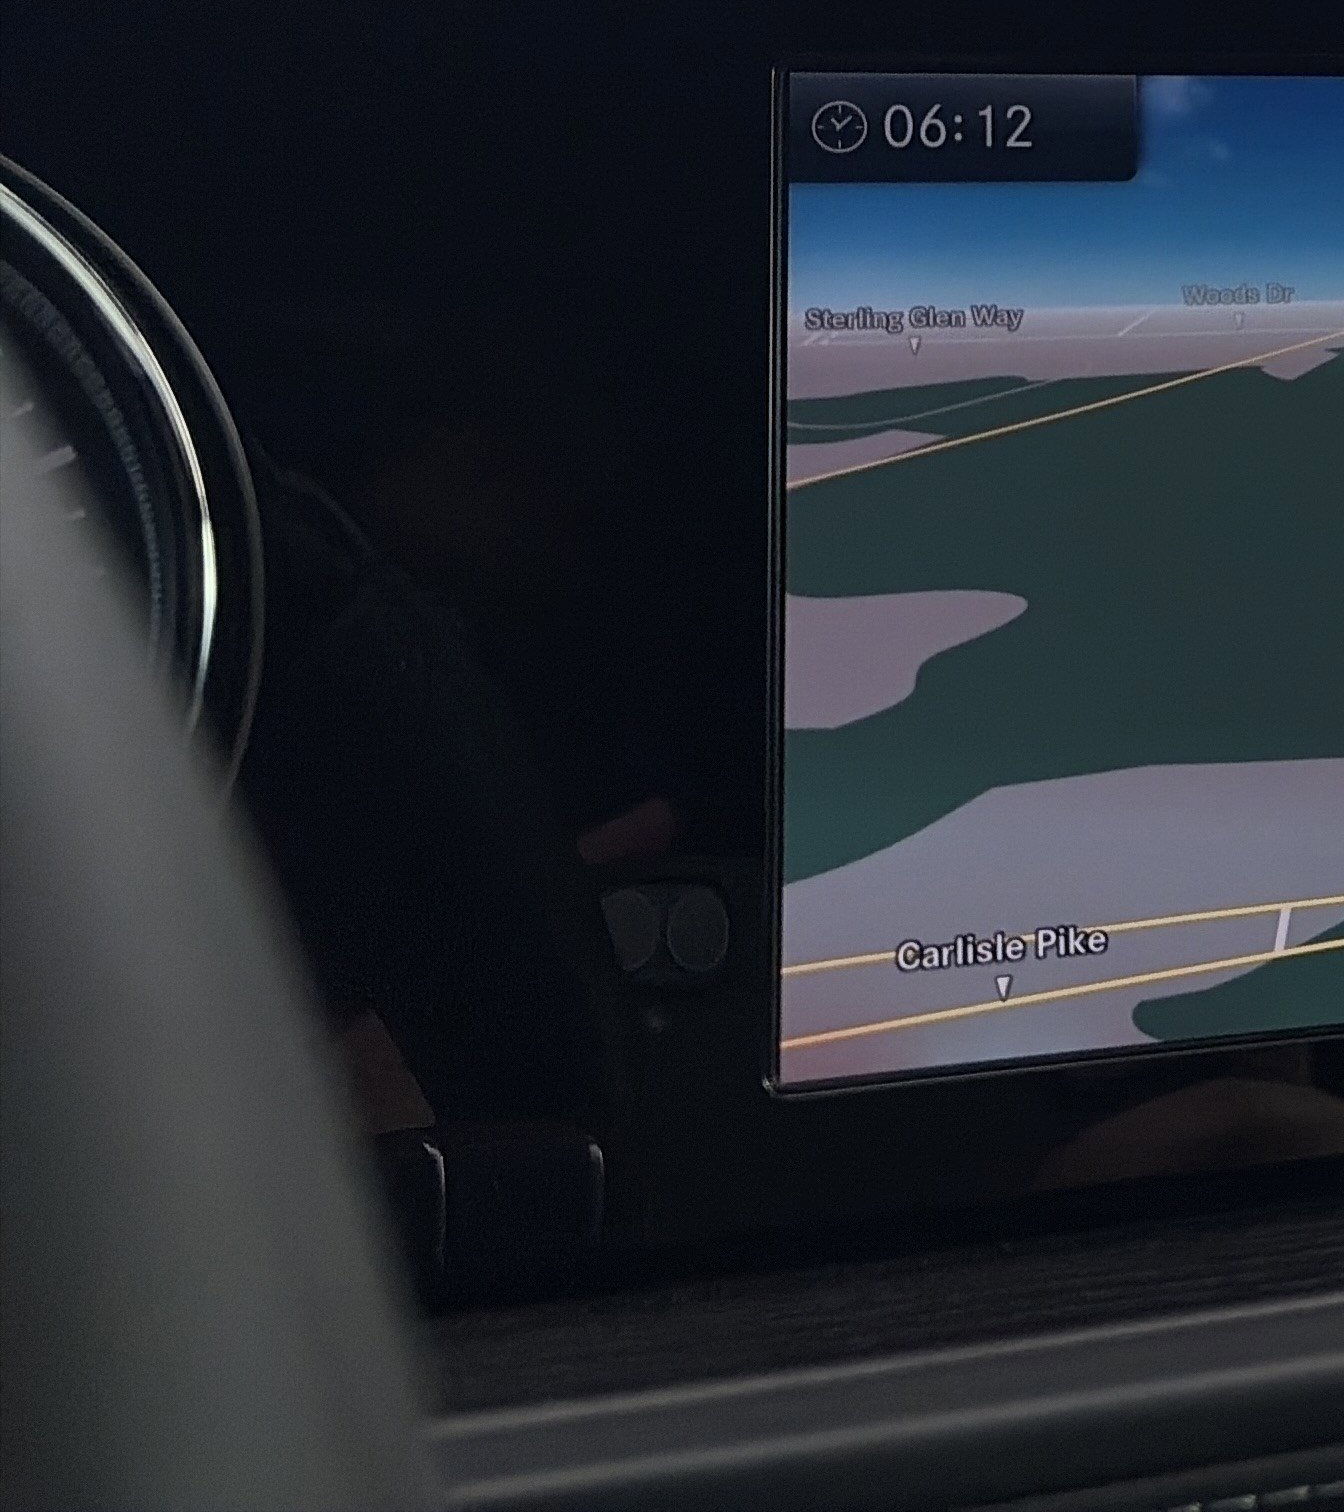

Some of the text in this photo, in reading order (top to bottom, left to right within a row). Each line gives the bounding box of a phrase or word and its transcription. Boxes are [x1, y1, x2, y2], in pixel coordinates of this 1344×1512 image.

[884, 103, 1033, 148] 06:12
[1182, 283, 1295, 305] Woods Dr
[805, 304, 1024, 333] Sterling Glen Way
[897, 925, 1107, 971] Carlisle Pike
